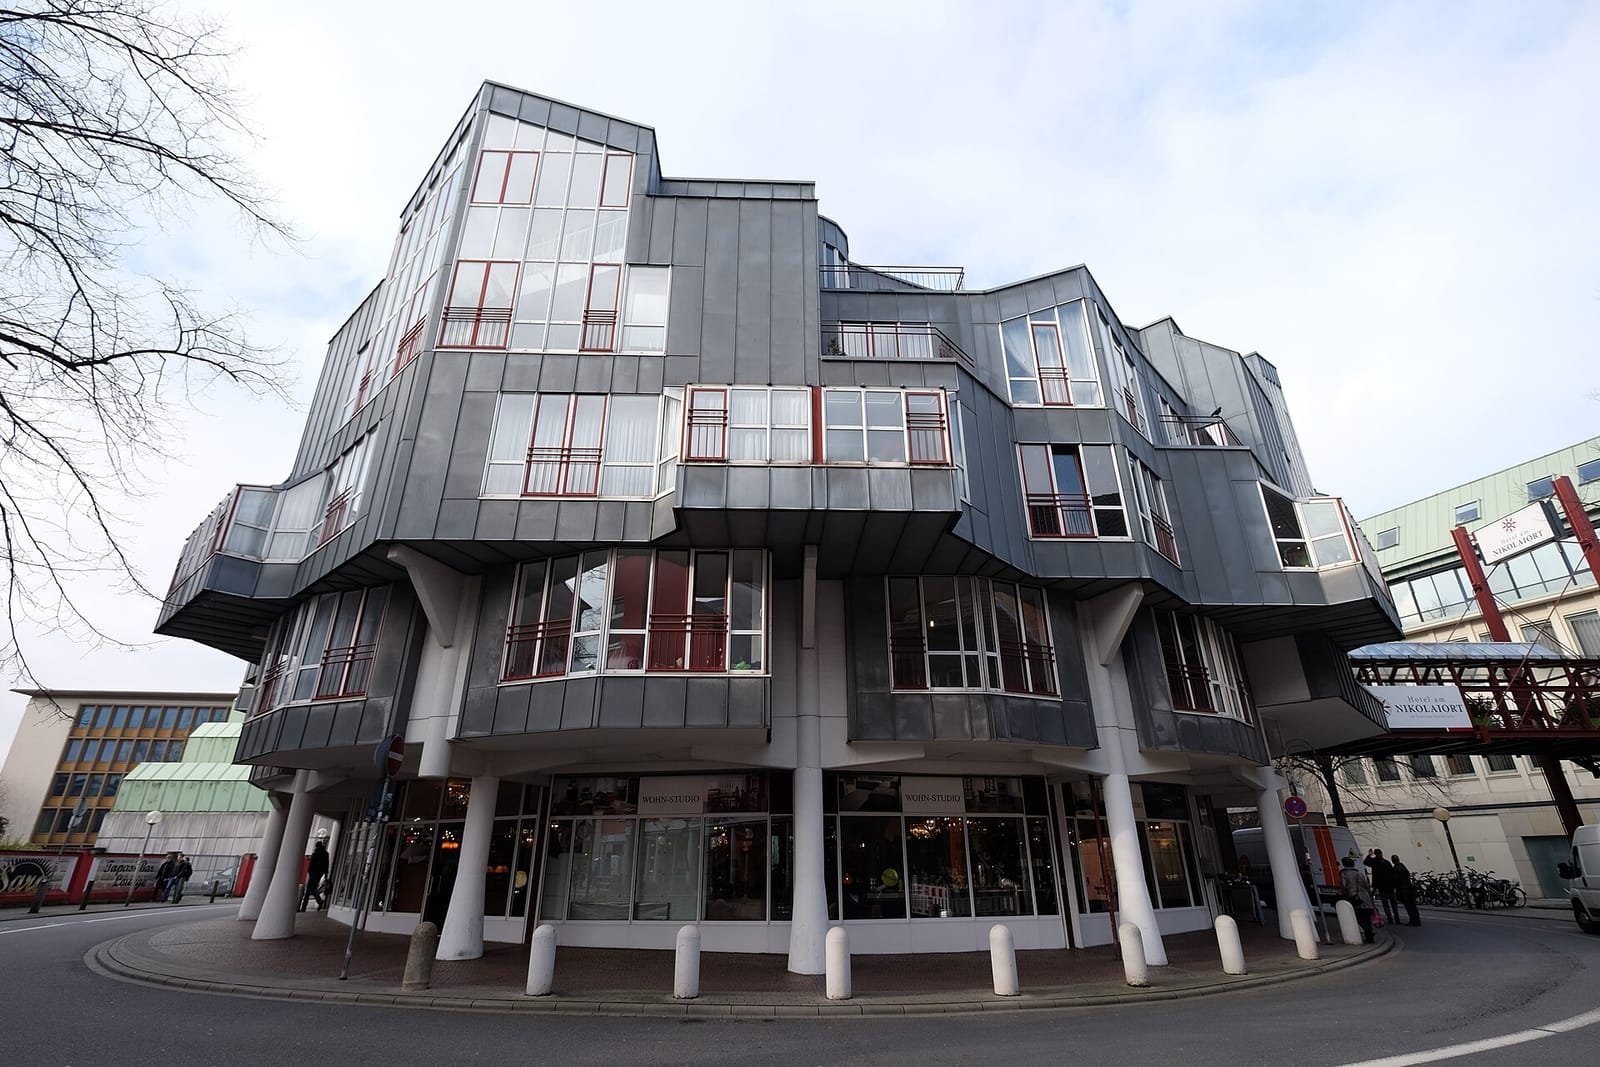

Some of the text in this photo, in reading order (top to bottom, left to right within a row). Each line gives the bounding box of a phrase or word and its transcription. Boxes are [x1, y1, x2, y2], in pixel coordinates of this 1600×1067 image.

[1492, 529, 1544, 557] NIKOLAIORT
[1407, 695, 1431, 703] Hotel
[1394, 704, 1464, 713] NIKOLAIORT
[642, 794, 700, 803] WOHN-STUDIO
[904, 793, 961, 802] WOHN-STUDIO
